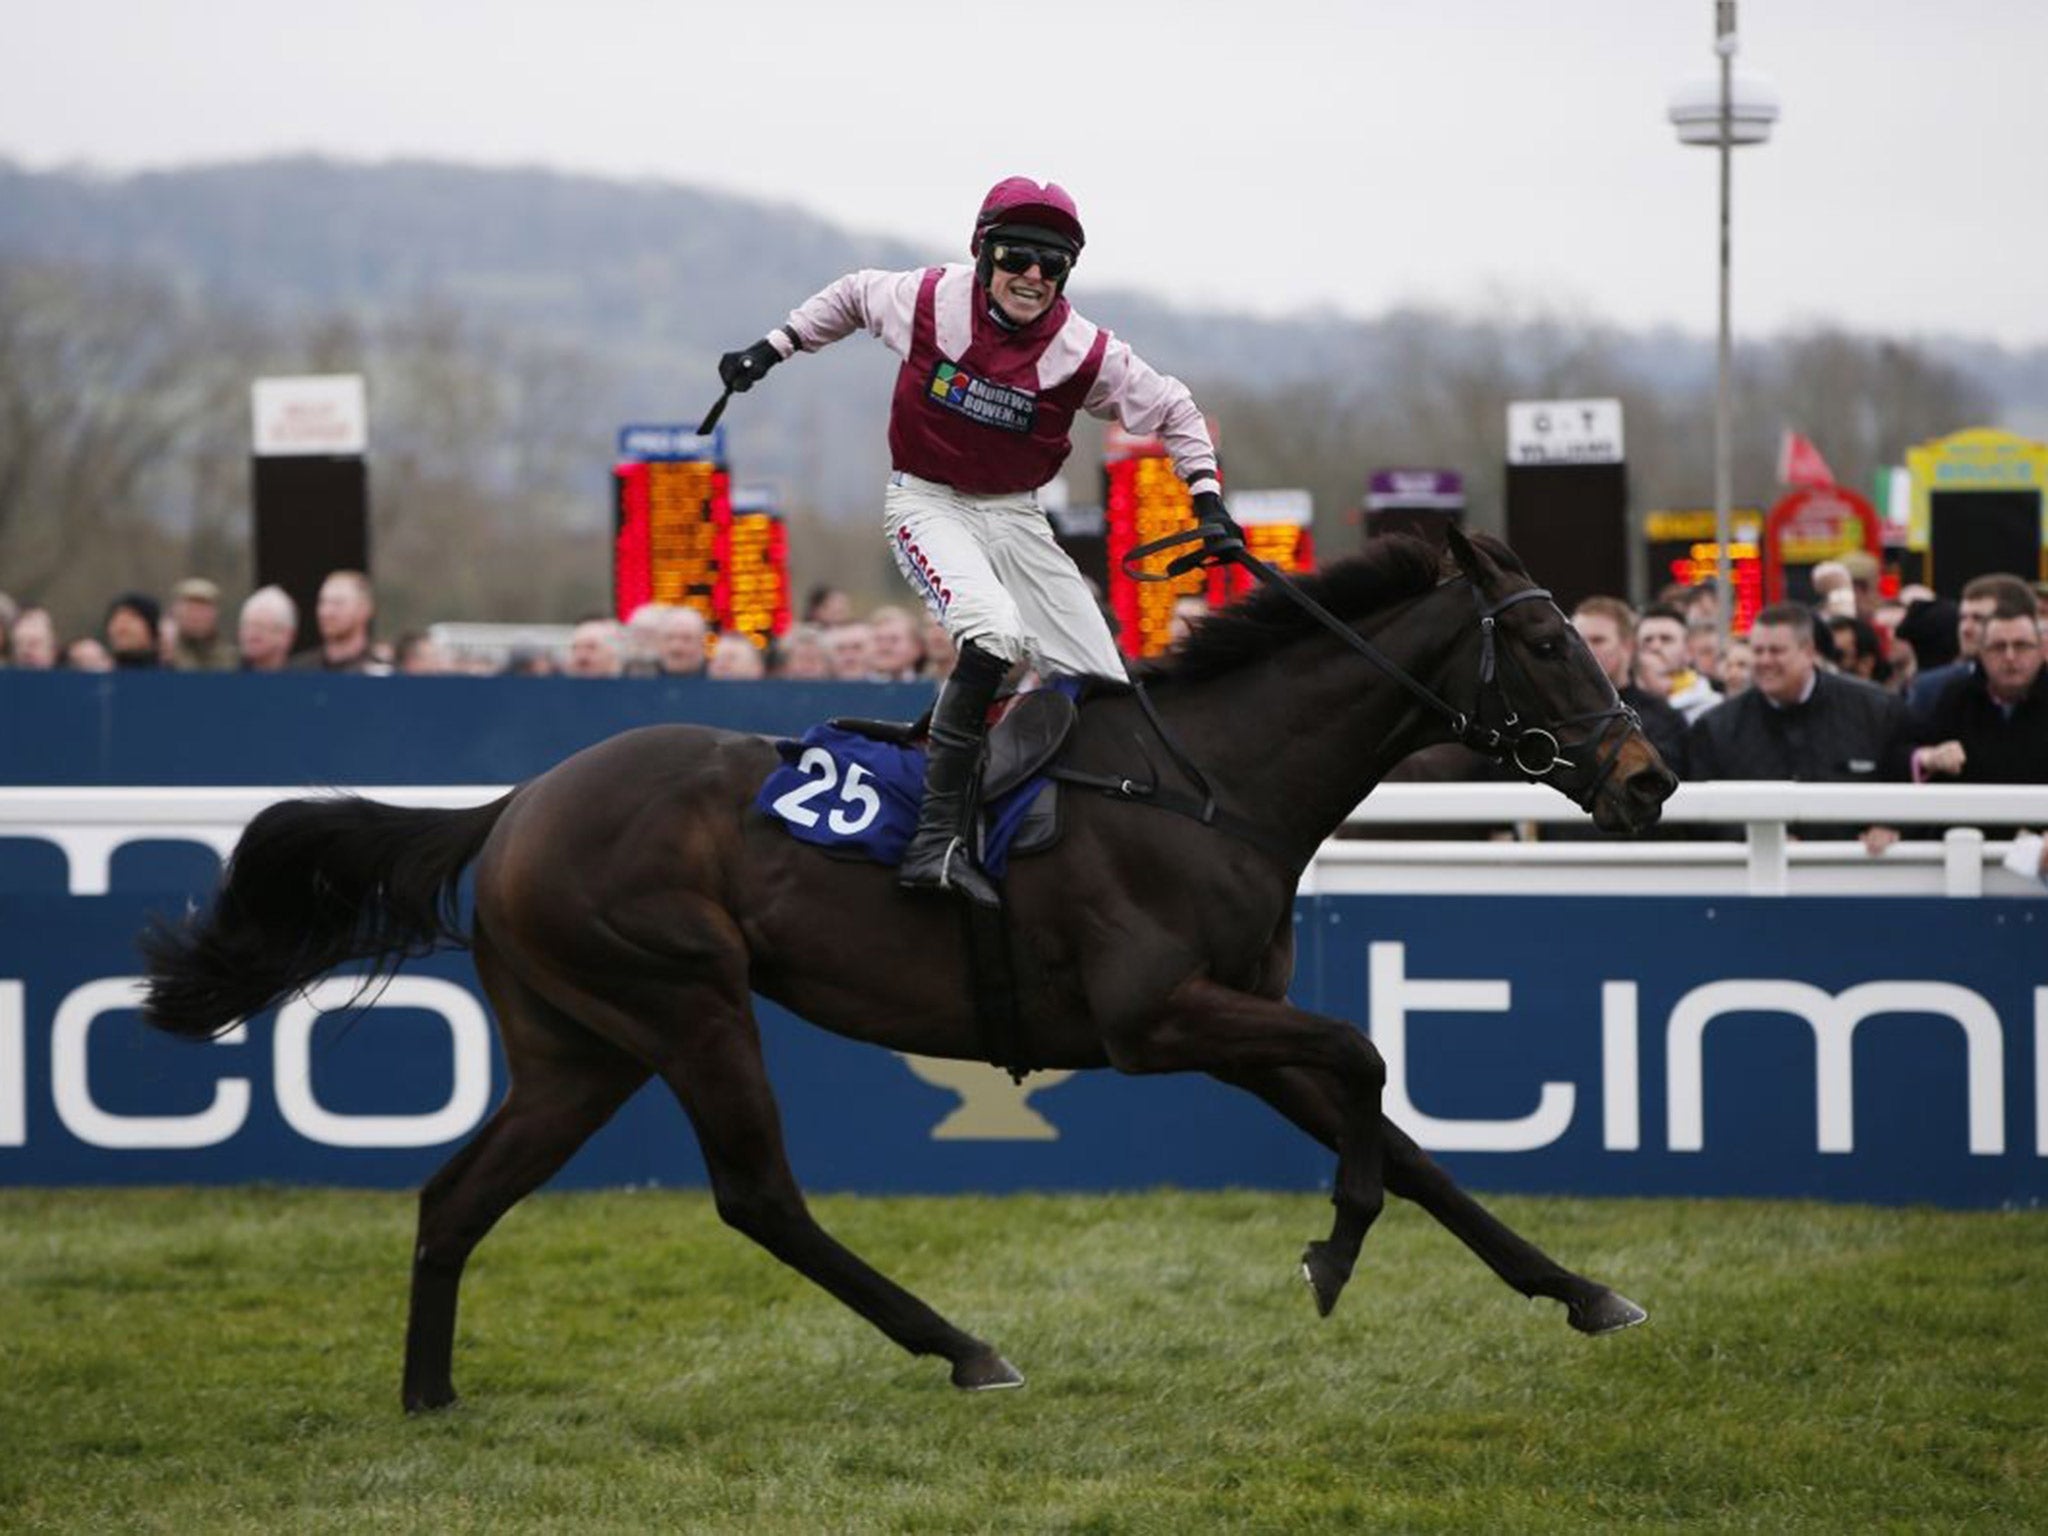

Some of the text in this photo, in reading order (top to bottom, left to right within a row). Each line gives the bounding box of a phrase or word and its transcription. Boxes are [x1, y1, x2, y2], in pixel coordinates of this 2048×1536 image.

[963, 395, 1012, 421] BOWEN
[967, 378, 1033, 413] ANDREWS
[772, 747, 880, 834] 25
